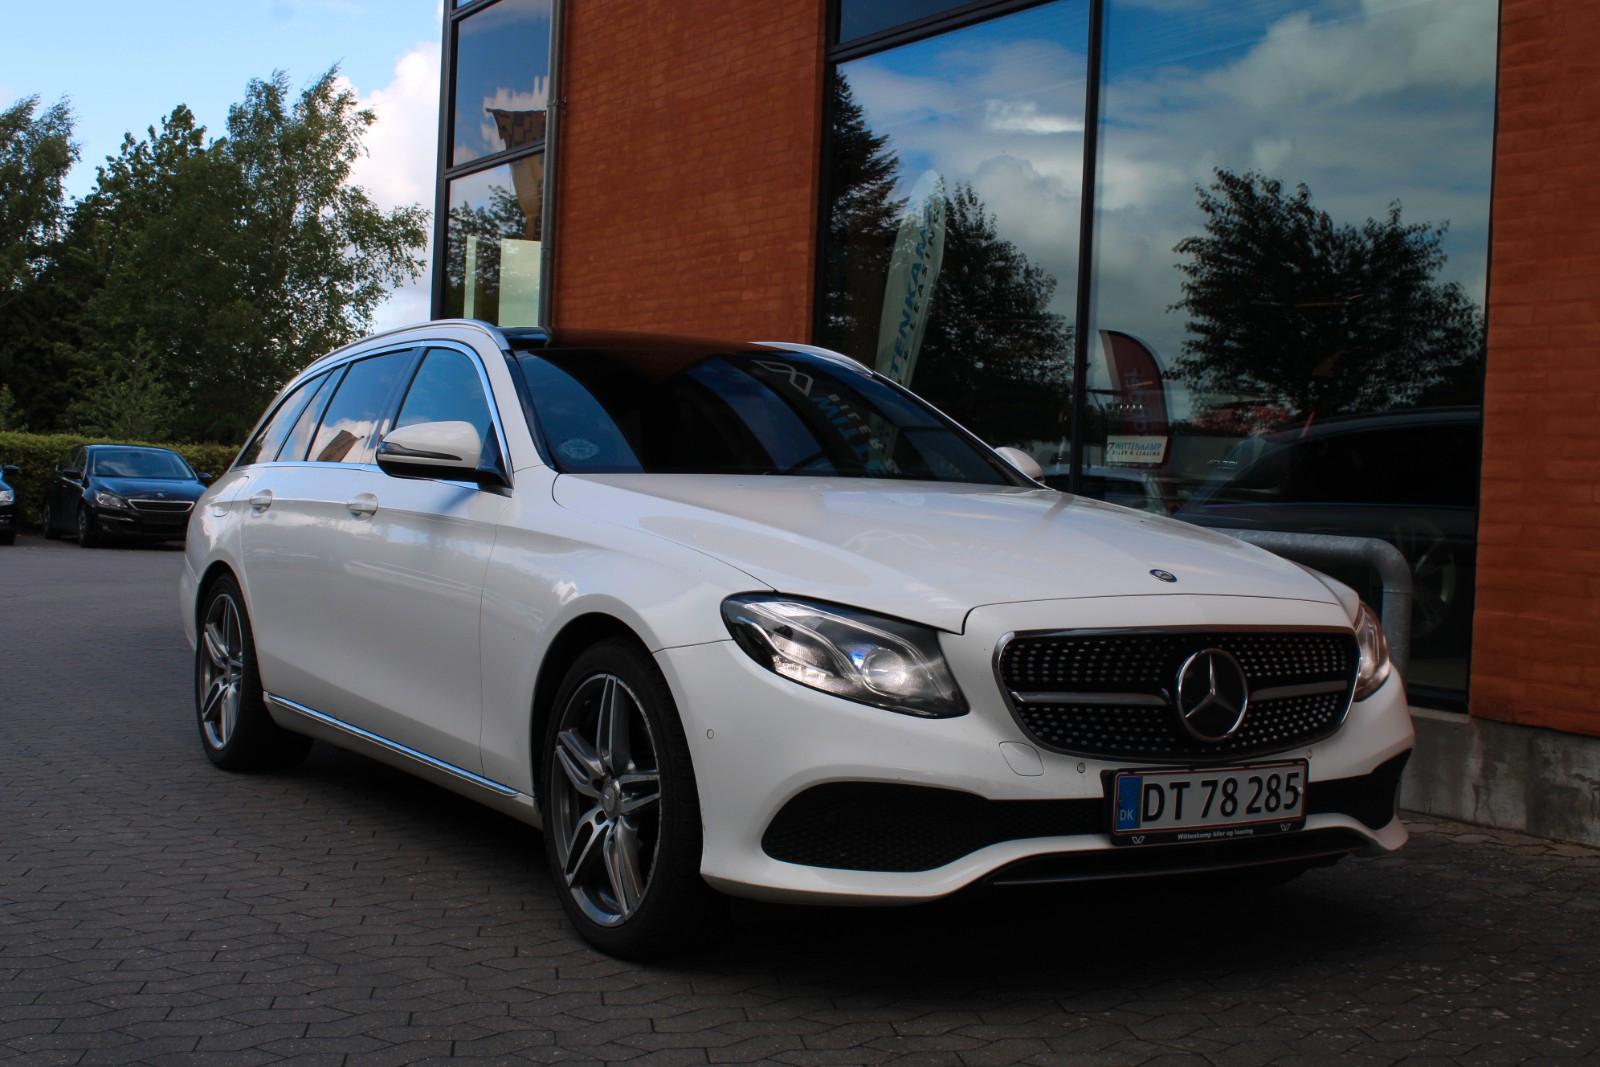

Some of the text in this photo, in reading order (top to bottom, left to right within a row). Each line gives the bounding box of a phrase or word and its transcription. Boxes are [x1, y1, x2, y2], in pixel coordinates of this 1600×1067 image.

[1142, 771, 1300, 822] DT 78 285
[1119, 808, 1134, 821] DK
